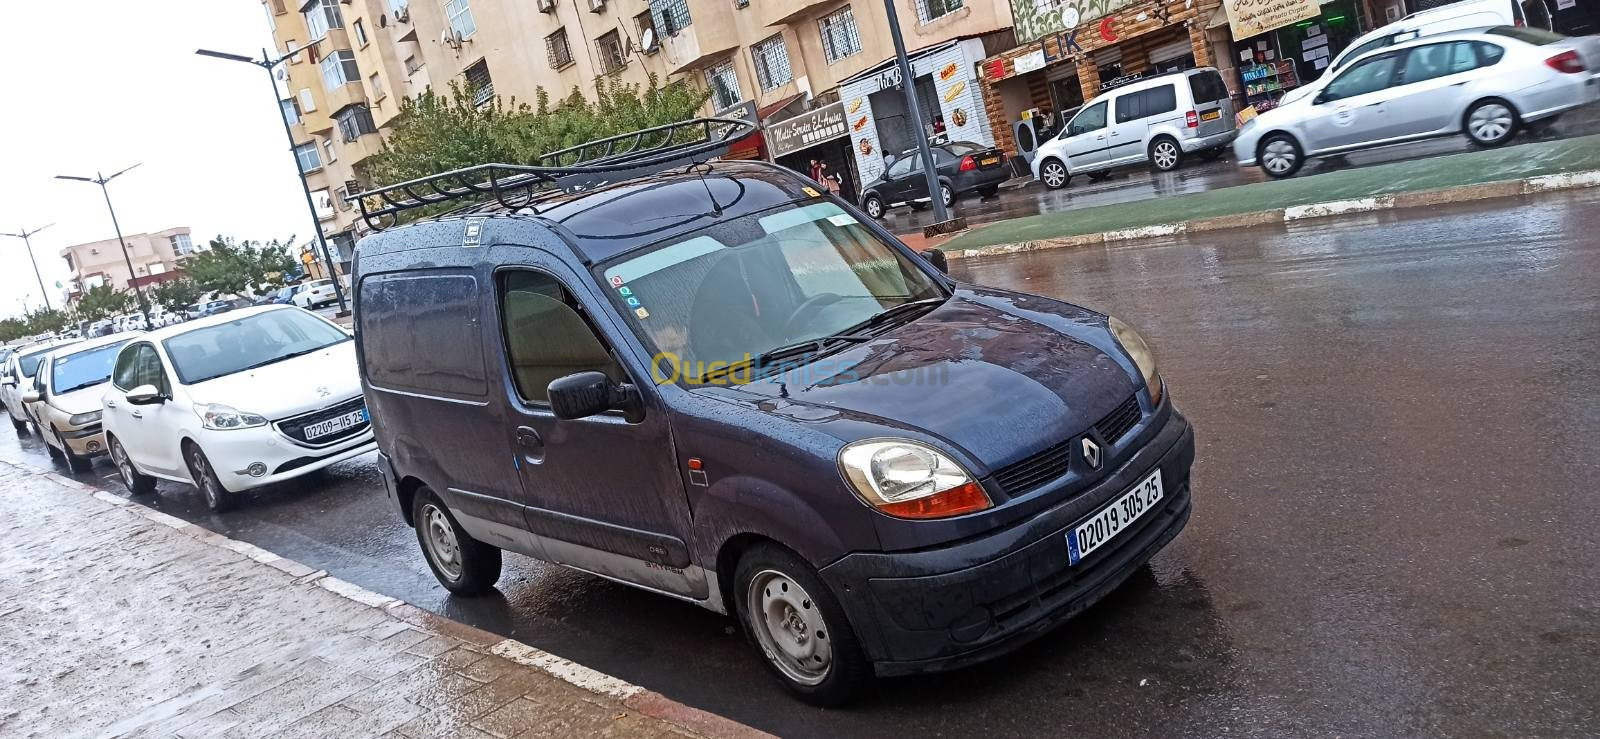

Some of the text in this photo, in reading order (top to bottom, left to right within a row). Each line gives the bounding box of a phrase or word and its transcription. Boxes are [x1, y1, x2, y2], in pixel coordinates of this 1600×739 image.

[875, 73, 892, 90] The
[353, 410, 364, 423] 25
[1078, 476, 1159, 554] 02019 305 25
